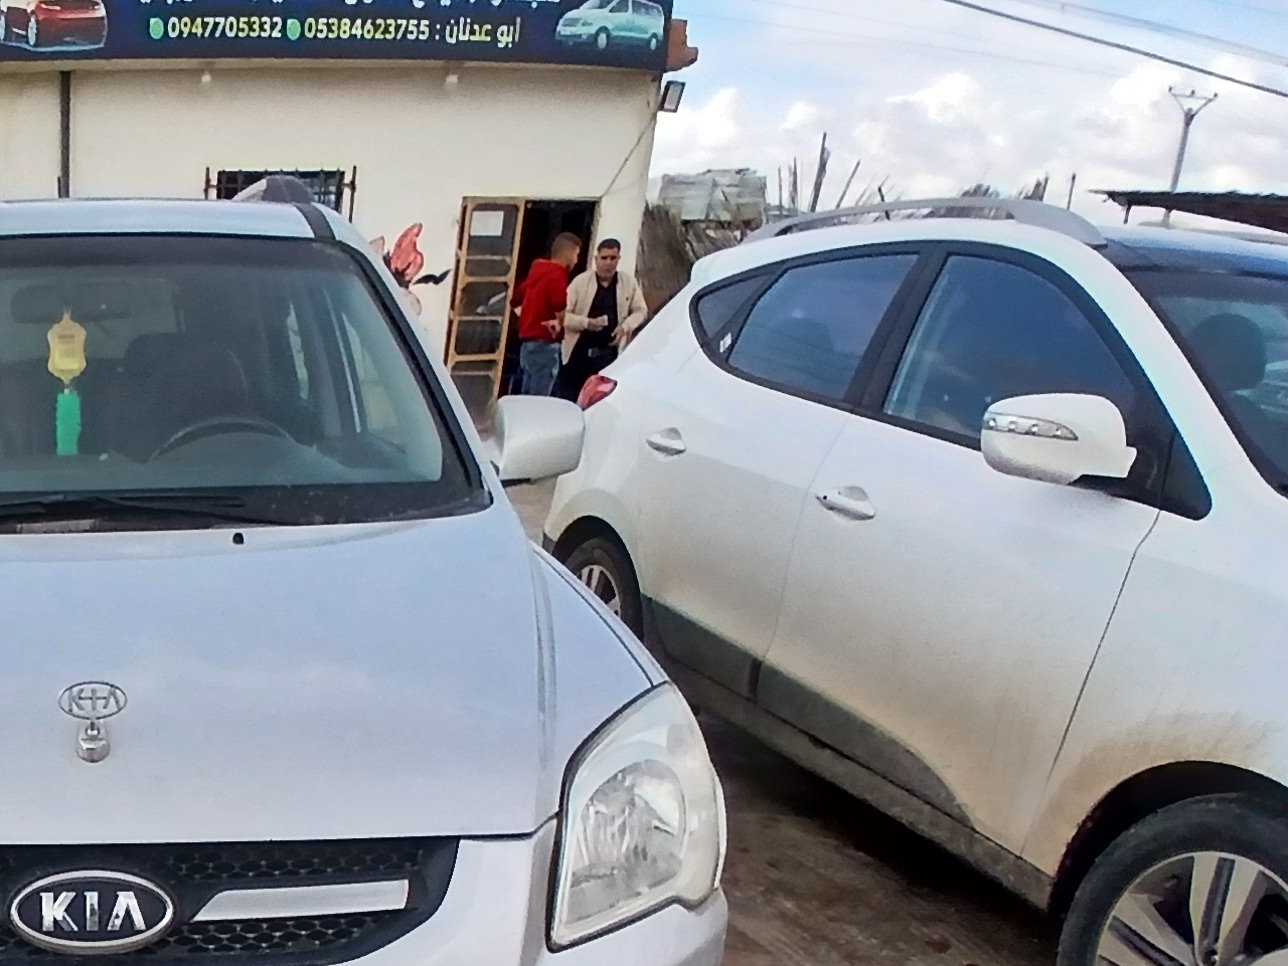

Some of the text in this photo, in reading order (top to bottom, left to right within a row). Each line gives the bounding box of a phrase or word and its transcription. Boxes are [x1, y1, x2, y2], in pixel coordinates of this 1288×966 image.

[167, 16, 283, 38] 0947705332
[304, 17, 430, 40] 05384623755
[445, 17, 492, 44] عدنان
[67, 684, 122, 712] KIA
[39, 890, 147, 933] KIA
